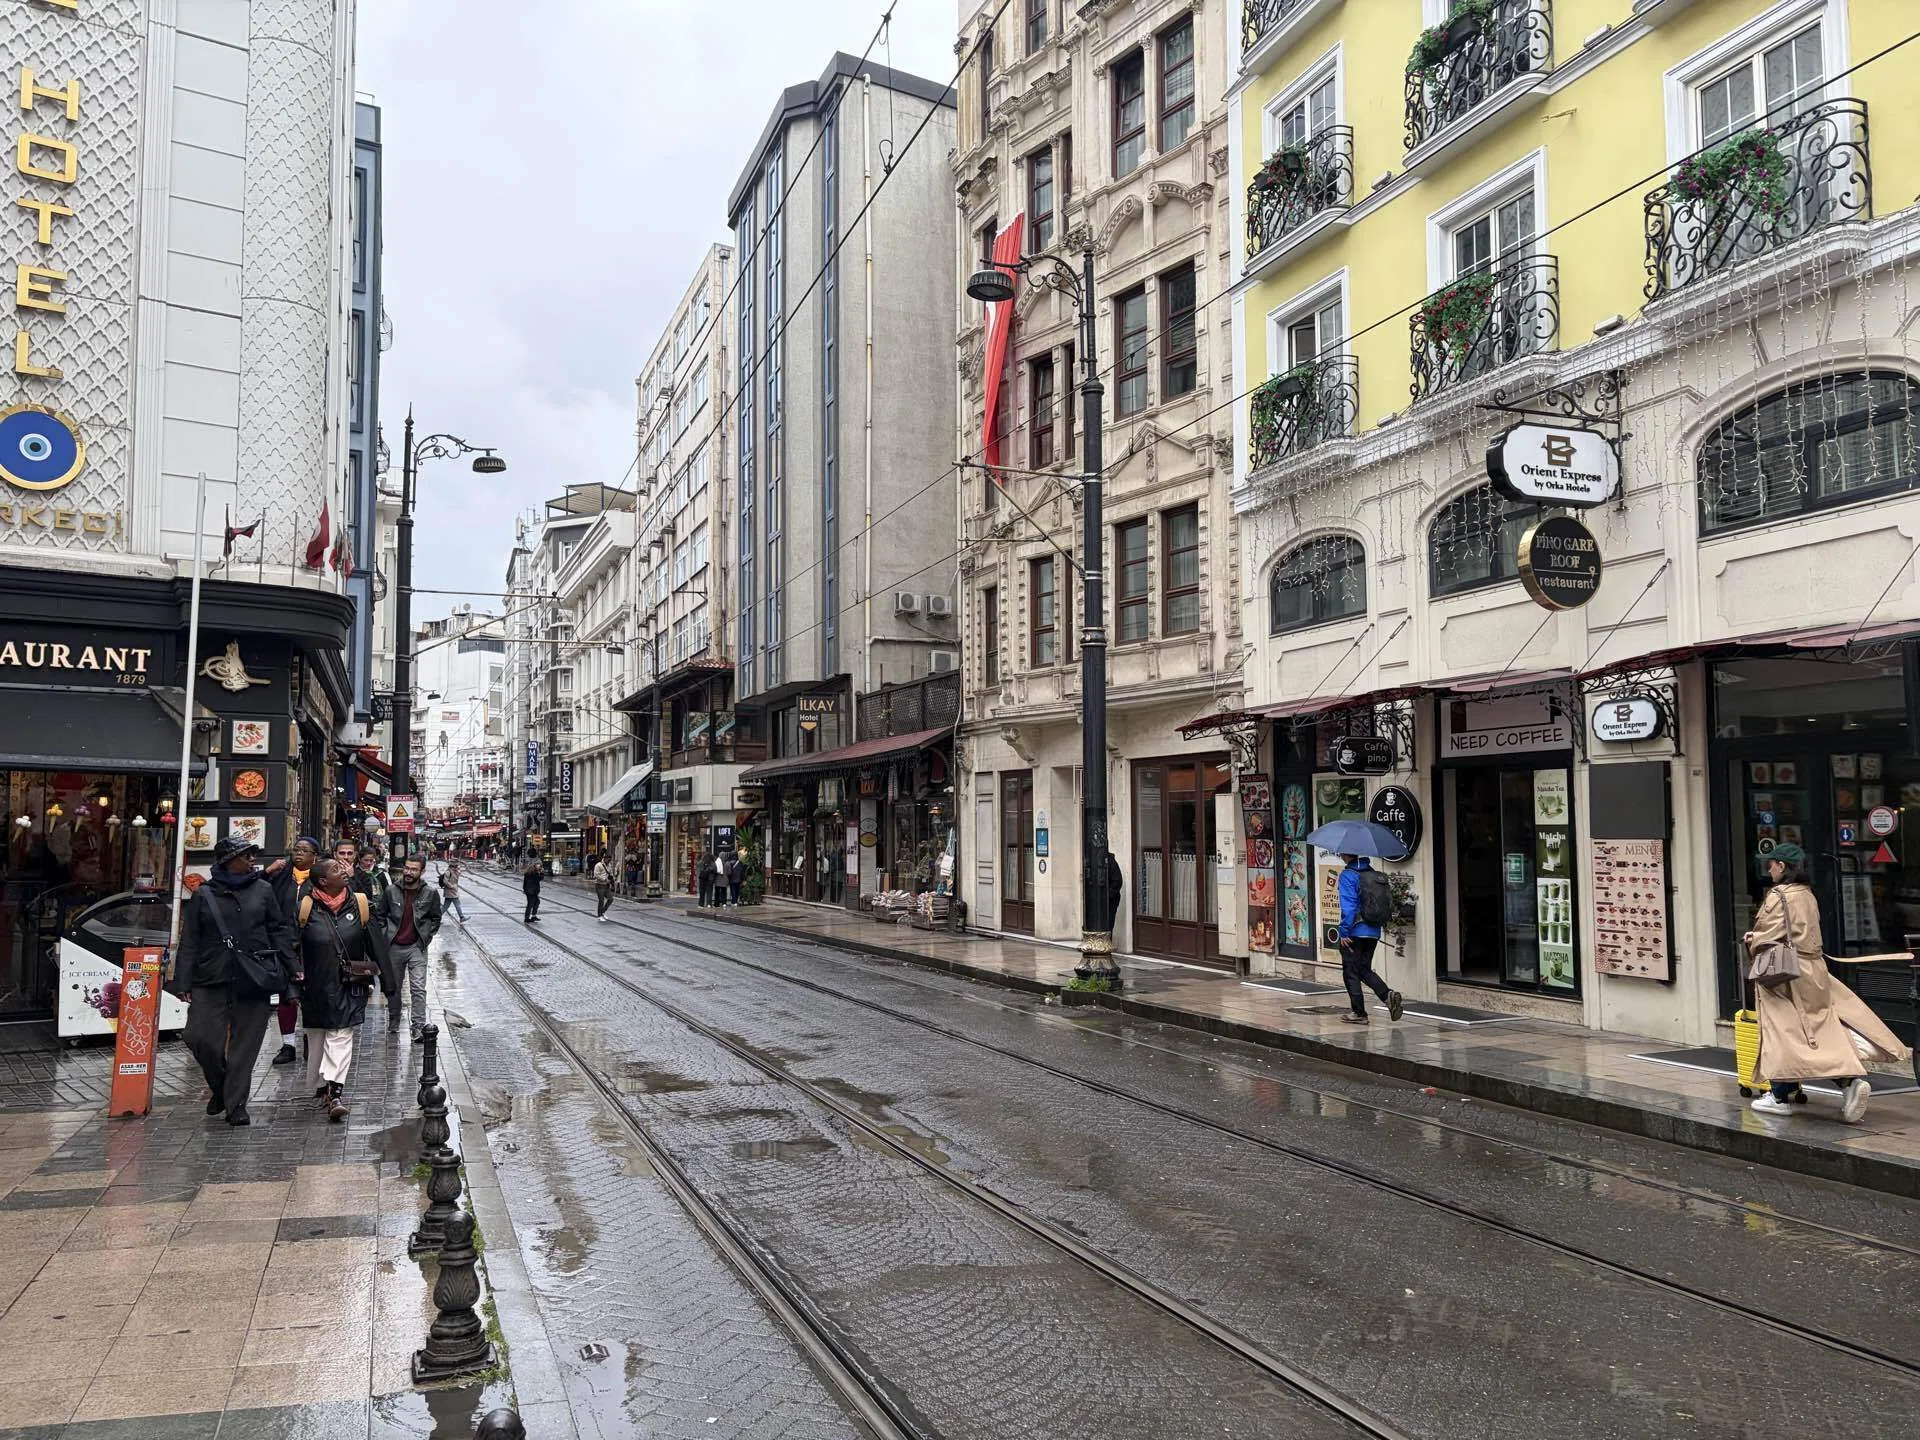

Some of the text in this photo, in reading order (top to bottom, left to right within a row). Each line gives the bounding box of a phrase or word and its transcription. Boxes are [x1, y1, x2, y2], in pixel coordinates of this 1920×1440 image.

[15, 66, 79, 379] HOTEL
[1521, 464, 1602, 484] Orient Express
[1534, 479, 1591, 493] by Orka Hotels
[1563, 537, 1595, 551] GARE
[1550, 554, 1581, 568] ROOF
[1539, 577, 1595, 589] restaurant
[0, 641, 151, 672] AURANT
[115, 674, 146, 685] 1879
[800, 697, 834, 711] İLKAY
[1624, 721, 1647, 731] Express
[1364, 742, 1389, 751] Caffe
[1450, 728, 1565, 751] NEED COFFEE
[1367, 753, 1387, 764] pino
[562, 762, 571, 791] DODO
[1376, 808, 1405, 822] Caffe
[1539, 832, 1566, 840] Matcha
[1625, 845, 1657, 855] MENU
